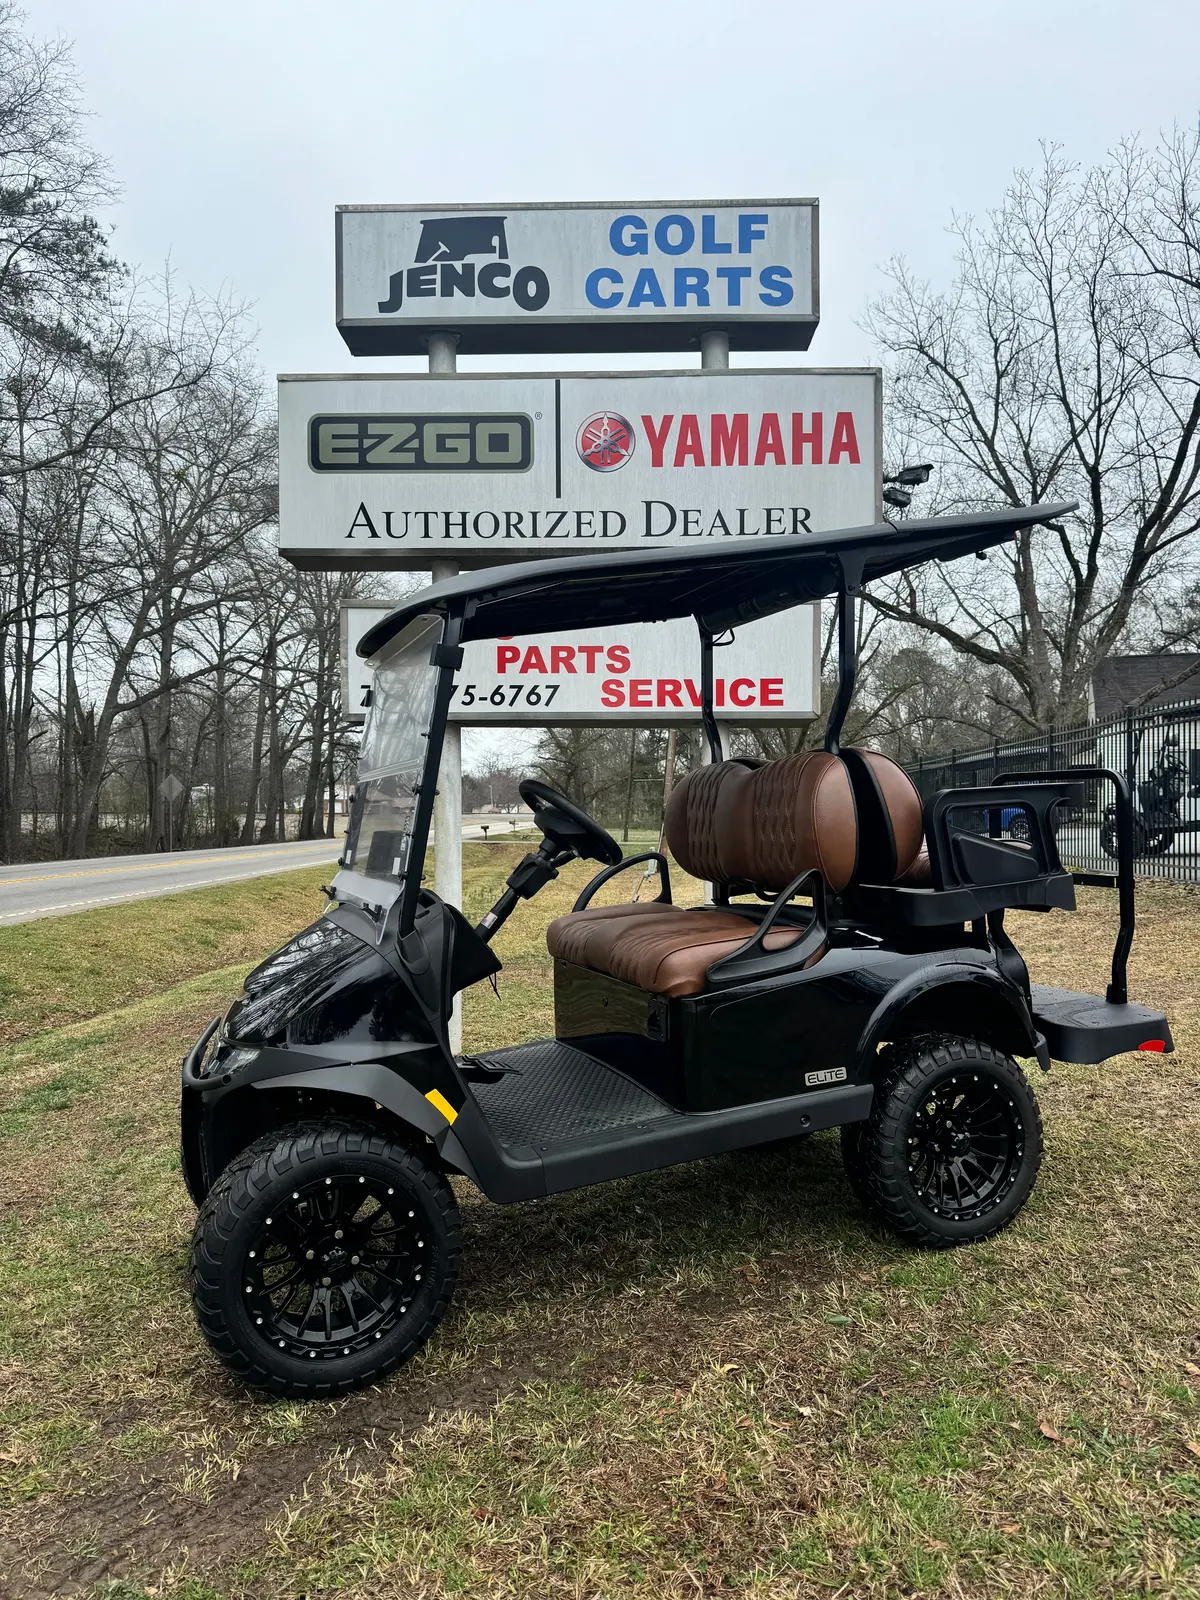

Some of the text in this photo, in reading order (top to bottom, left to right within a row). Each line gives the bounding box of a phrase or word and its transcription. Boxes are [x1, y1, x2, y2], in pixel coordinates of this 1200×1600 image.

[610, 213, 769, 257] GOLF
[377, 262, 551, 314] JENCO
[585, 265, 794, 309] CARTS
[641, 411, 861, 468] YAMAHA
[344, 500, 814, 539] AUTHORIZED DEALER
[496, 645, 631, 674] PARTS
